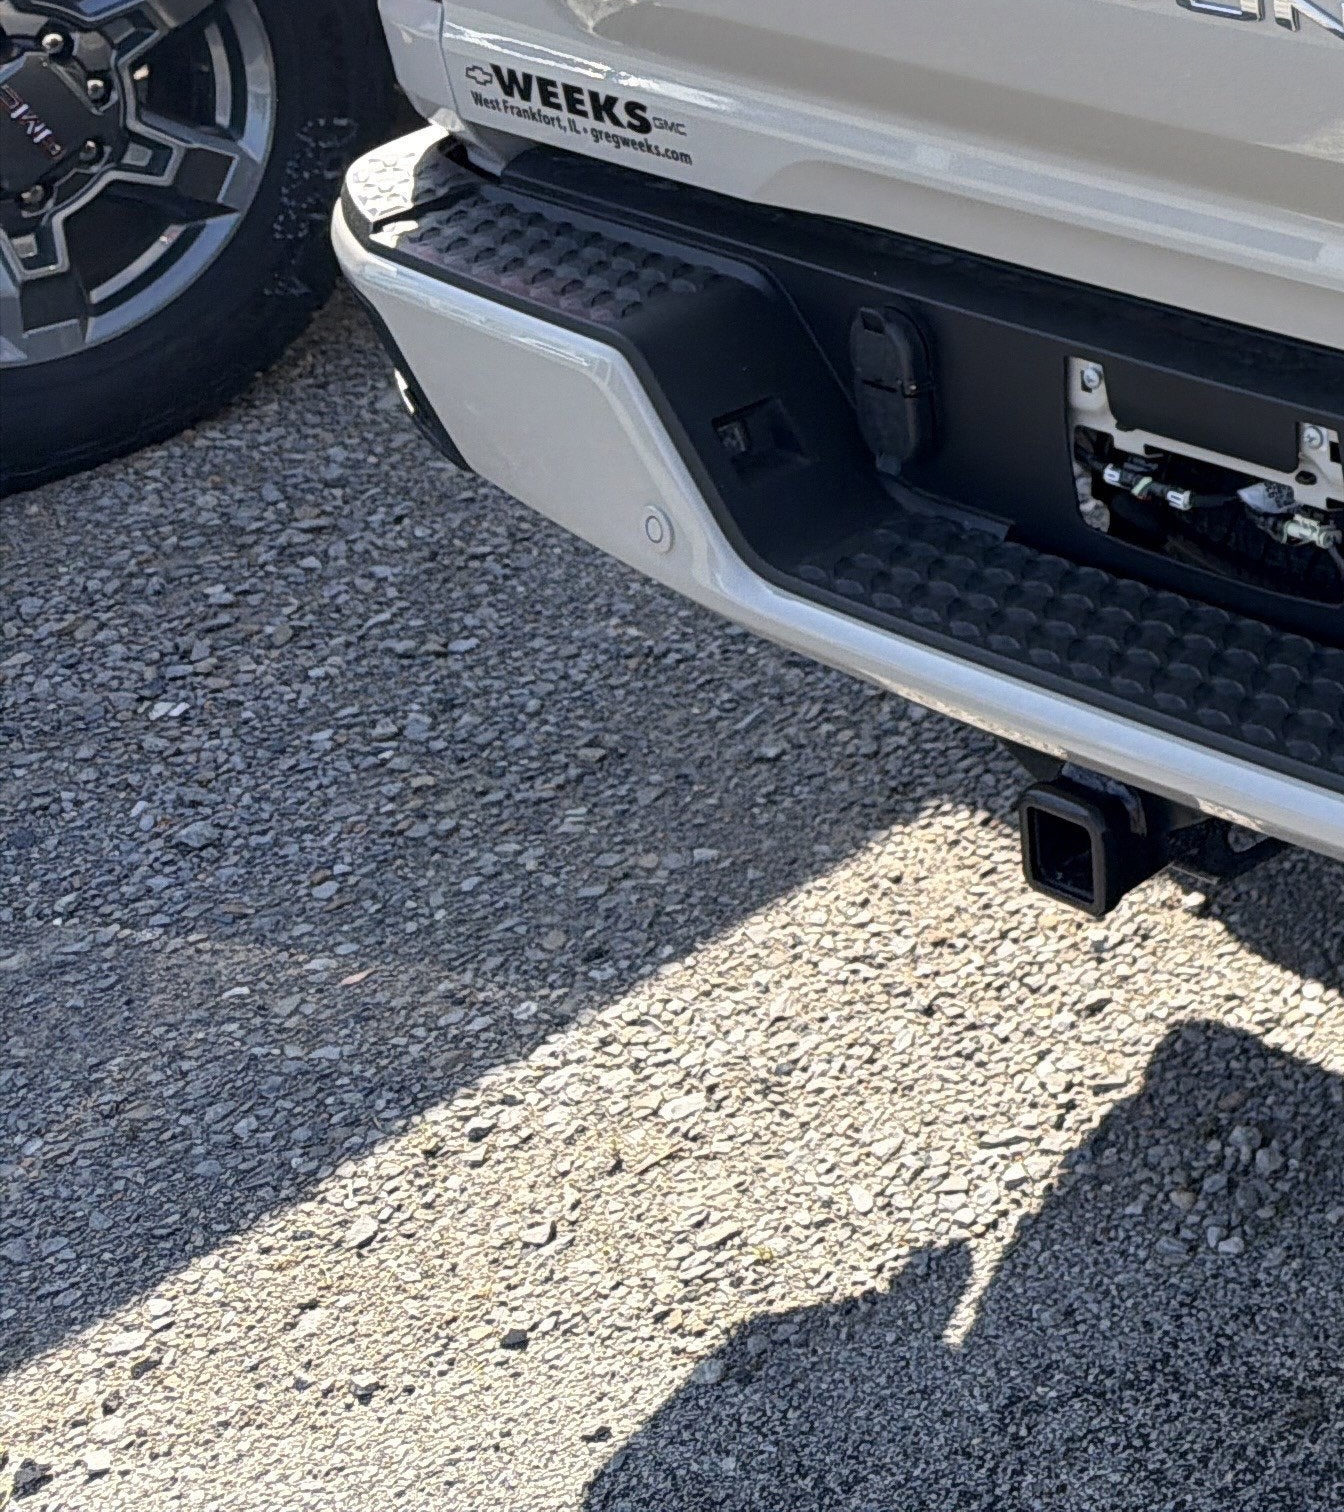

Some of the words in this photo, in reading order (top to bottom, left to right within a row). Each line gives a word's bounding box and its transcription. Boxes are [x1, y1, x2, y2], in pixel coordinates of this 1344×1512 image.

[0, 84, 67, 162] GMC
[470, 90, 503, 113] West
[503, 99, 568, 133] Frankfort,
[590, 127, 694, 166] gregweeks.com
[490, 63, 653, 135] WEEKS
[652, 116, 688, 137] GMC
